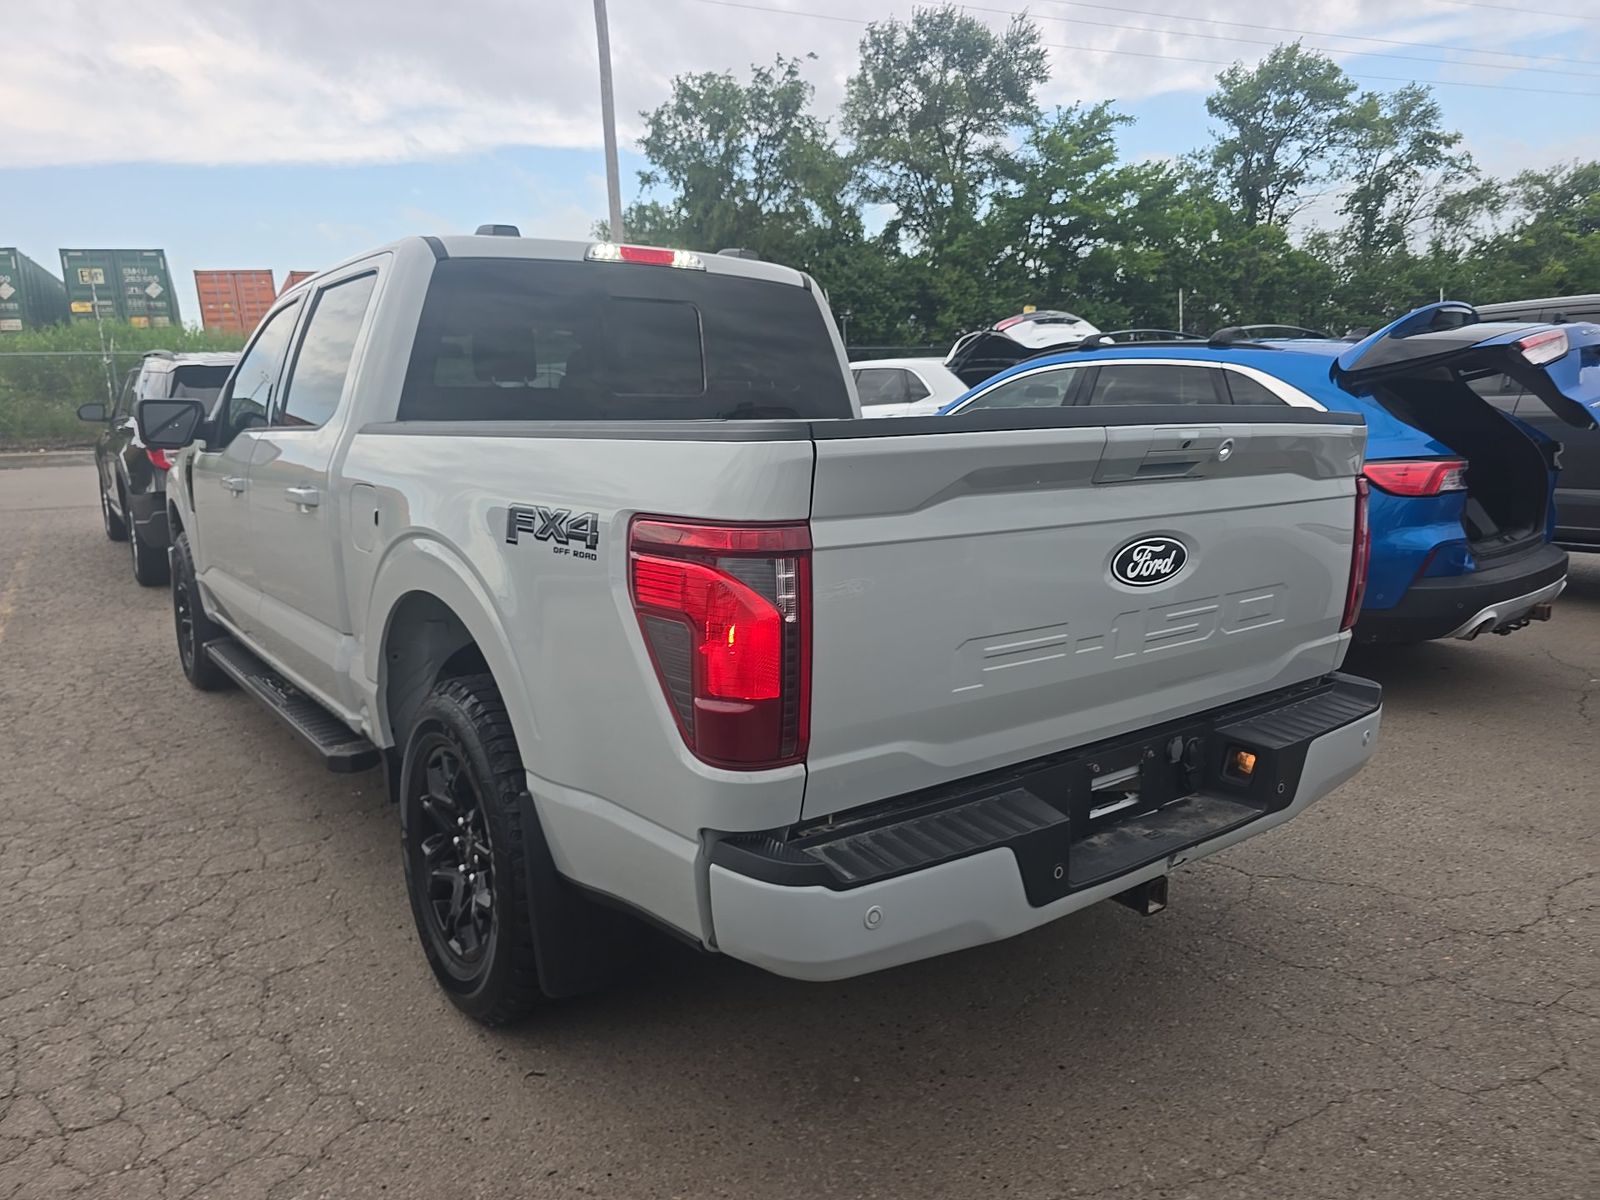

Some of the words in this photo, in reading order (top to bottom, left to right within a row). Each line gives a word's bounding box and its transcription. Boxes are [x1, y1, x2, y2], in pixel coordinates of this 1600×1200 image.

[506, 503, 599, 550] FX4
[553, 546, 570, 555] OFF
[573, 550, 597, 561] ROAD
[1126, 544, 1177, 579] Ford
[952, 582, 1288, 693] F-150
